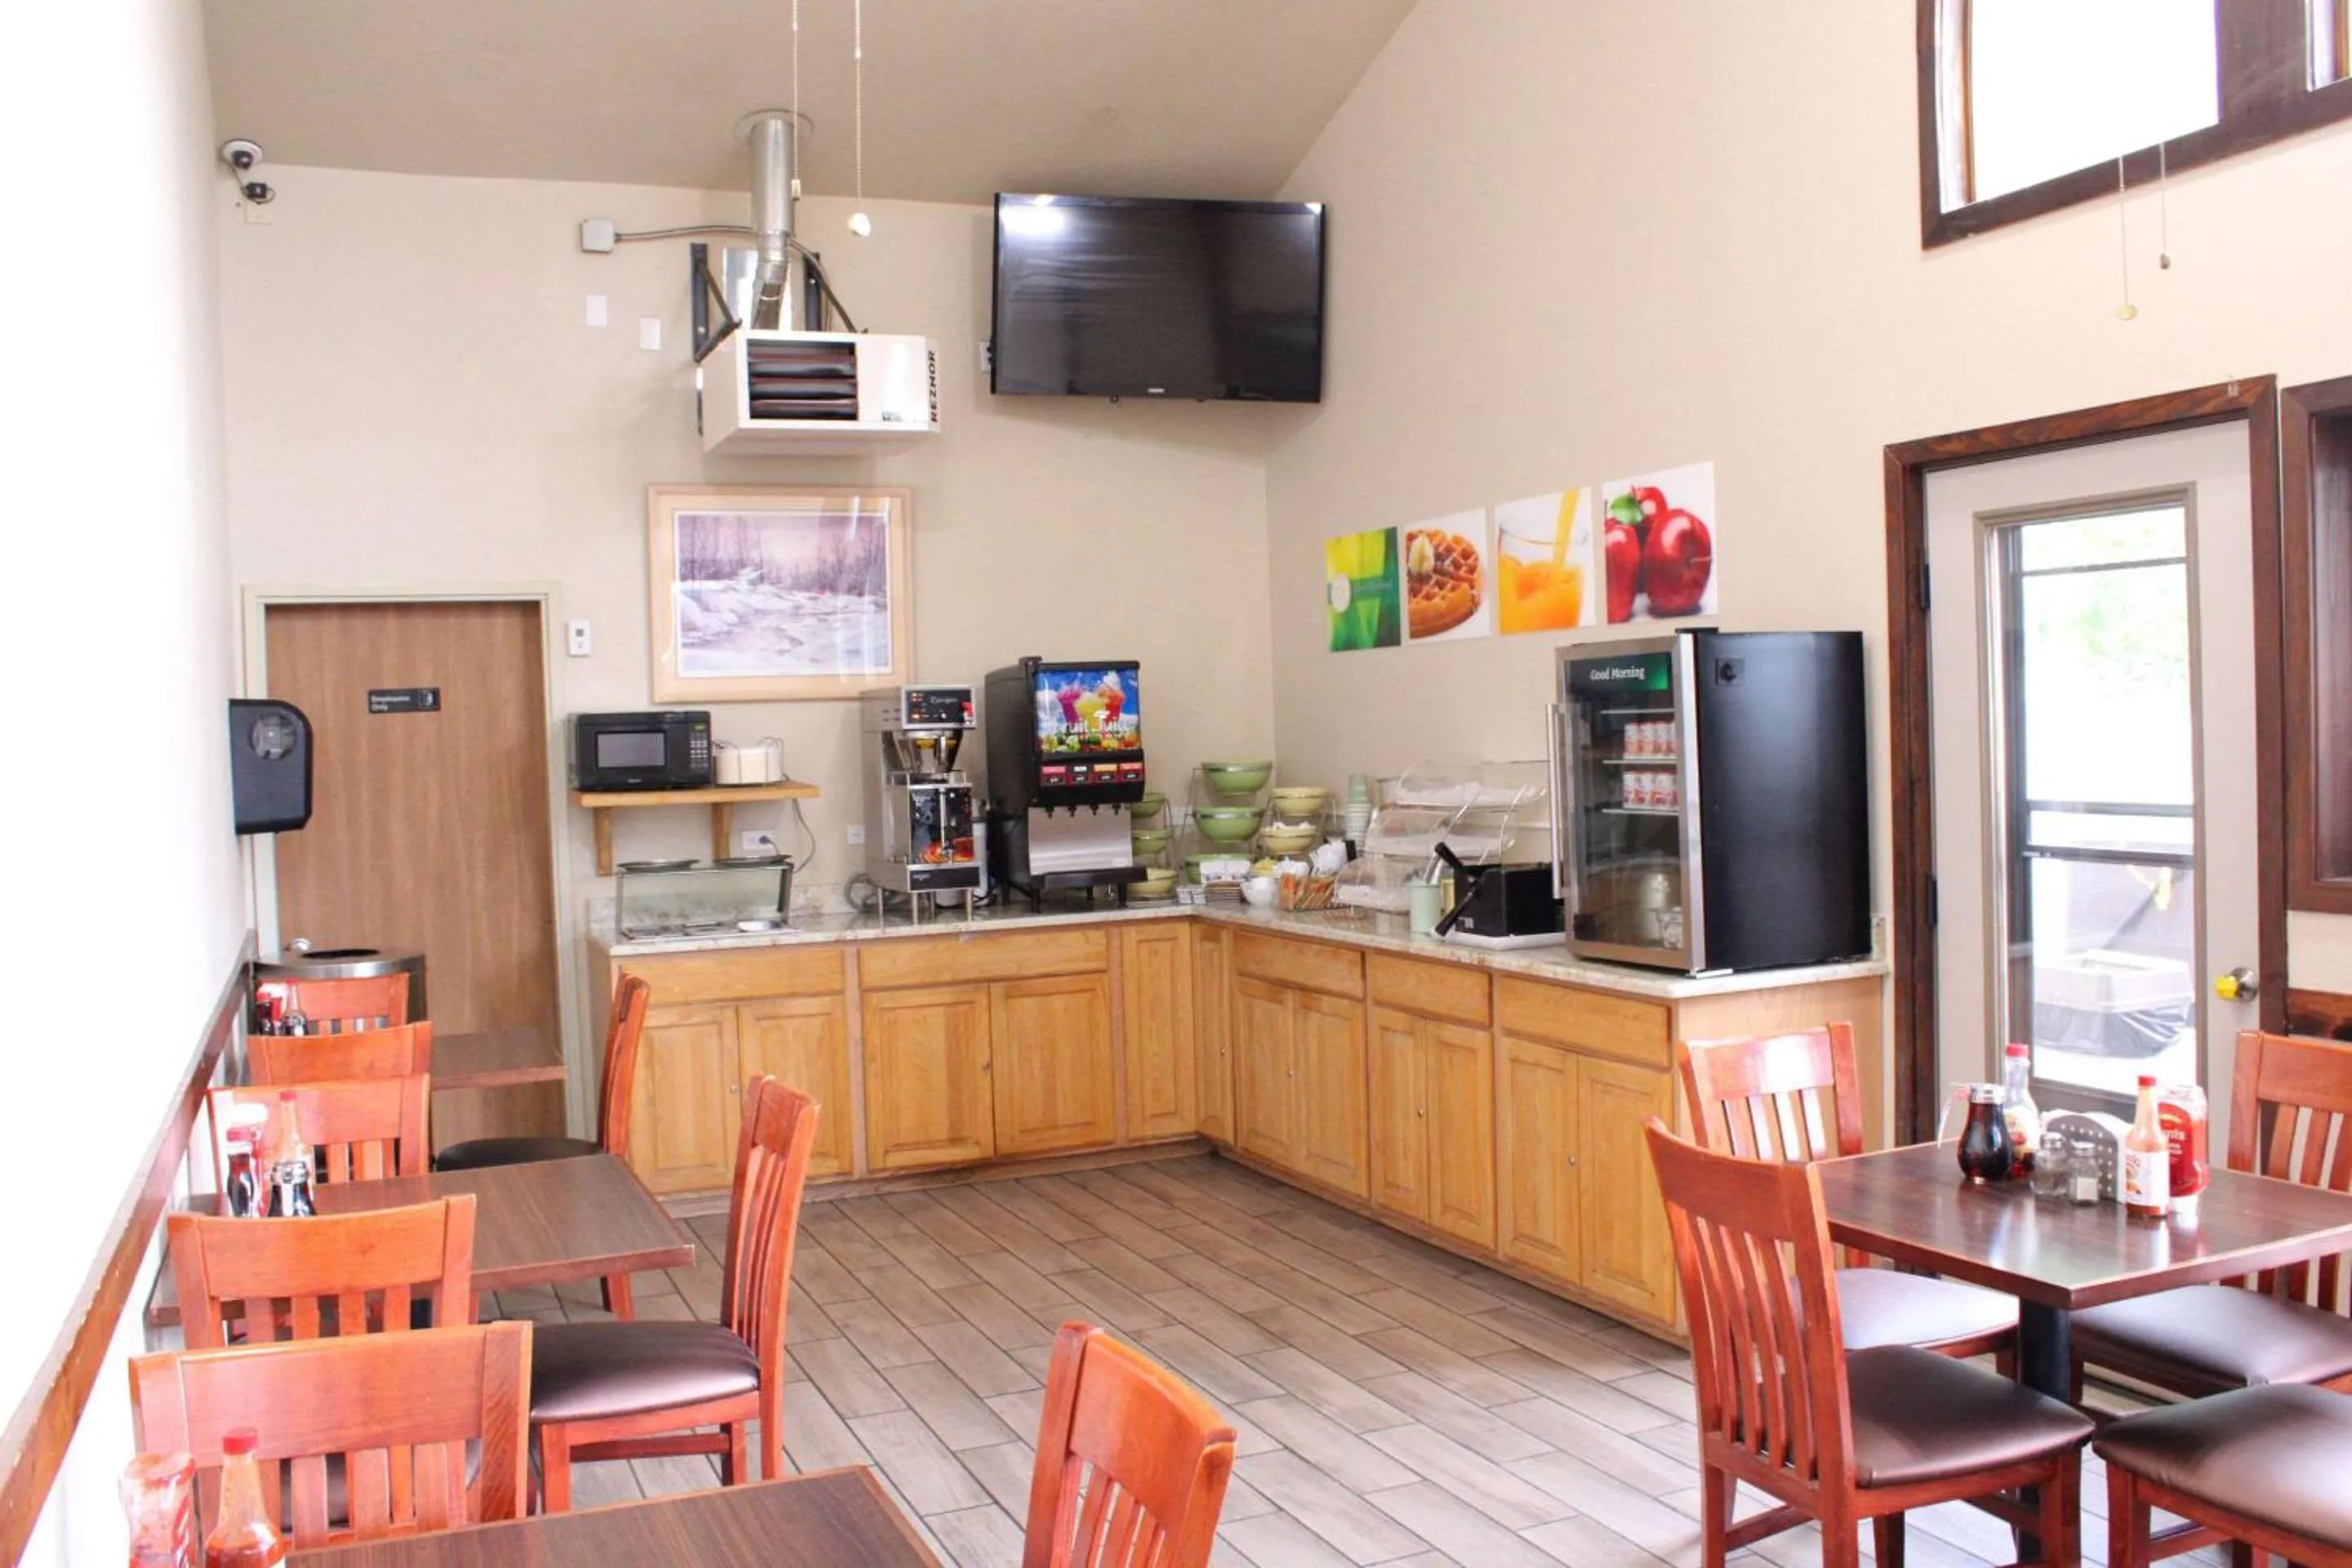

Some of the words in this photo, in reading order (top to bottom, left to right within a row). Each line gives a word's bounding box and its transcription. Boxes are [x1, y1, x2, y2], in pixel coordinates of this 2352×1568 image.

[927, 350, 938, 423] REZNOR
[1589, 667, 1610, 680] Good
[1611, 666, 1645, 680] Morning
